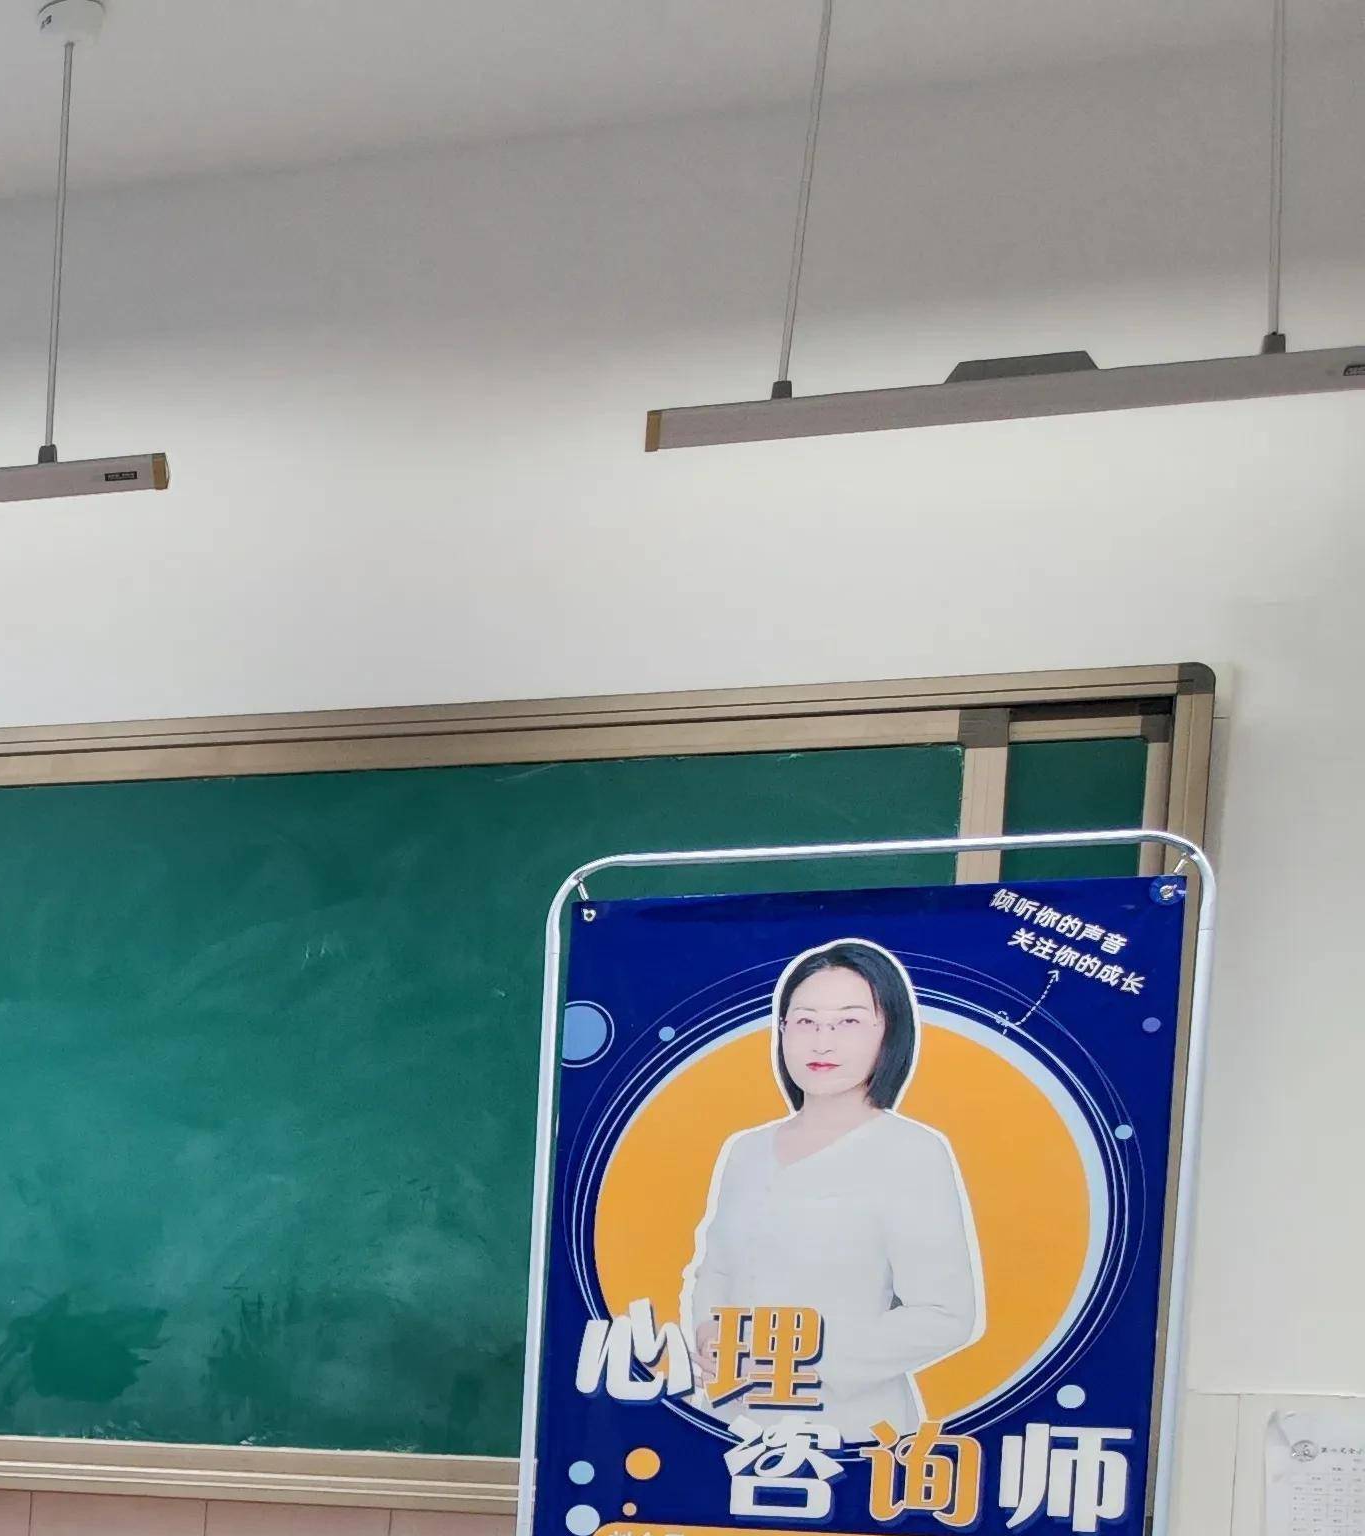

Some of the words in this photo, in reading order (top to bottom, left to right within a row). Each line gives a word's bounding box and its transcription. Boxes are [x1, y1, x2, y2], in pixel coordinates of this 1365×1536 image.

[988, 887, 1128, 955] 倾听你的声音
[1006, 926, 1146, 996] 关注你的成长
[575, 1298, 822, 1406] 心理
[723, 1414, 1133, 1533] 咨询师
